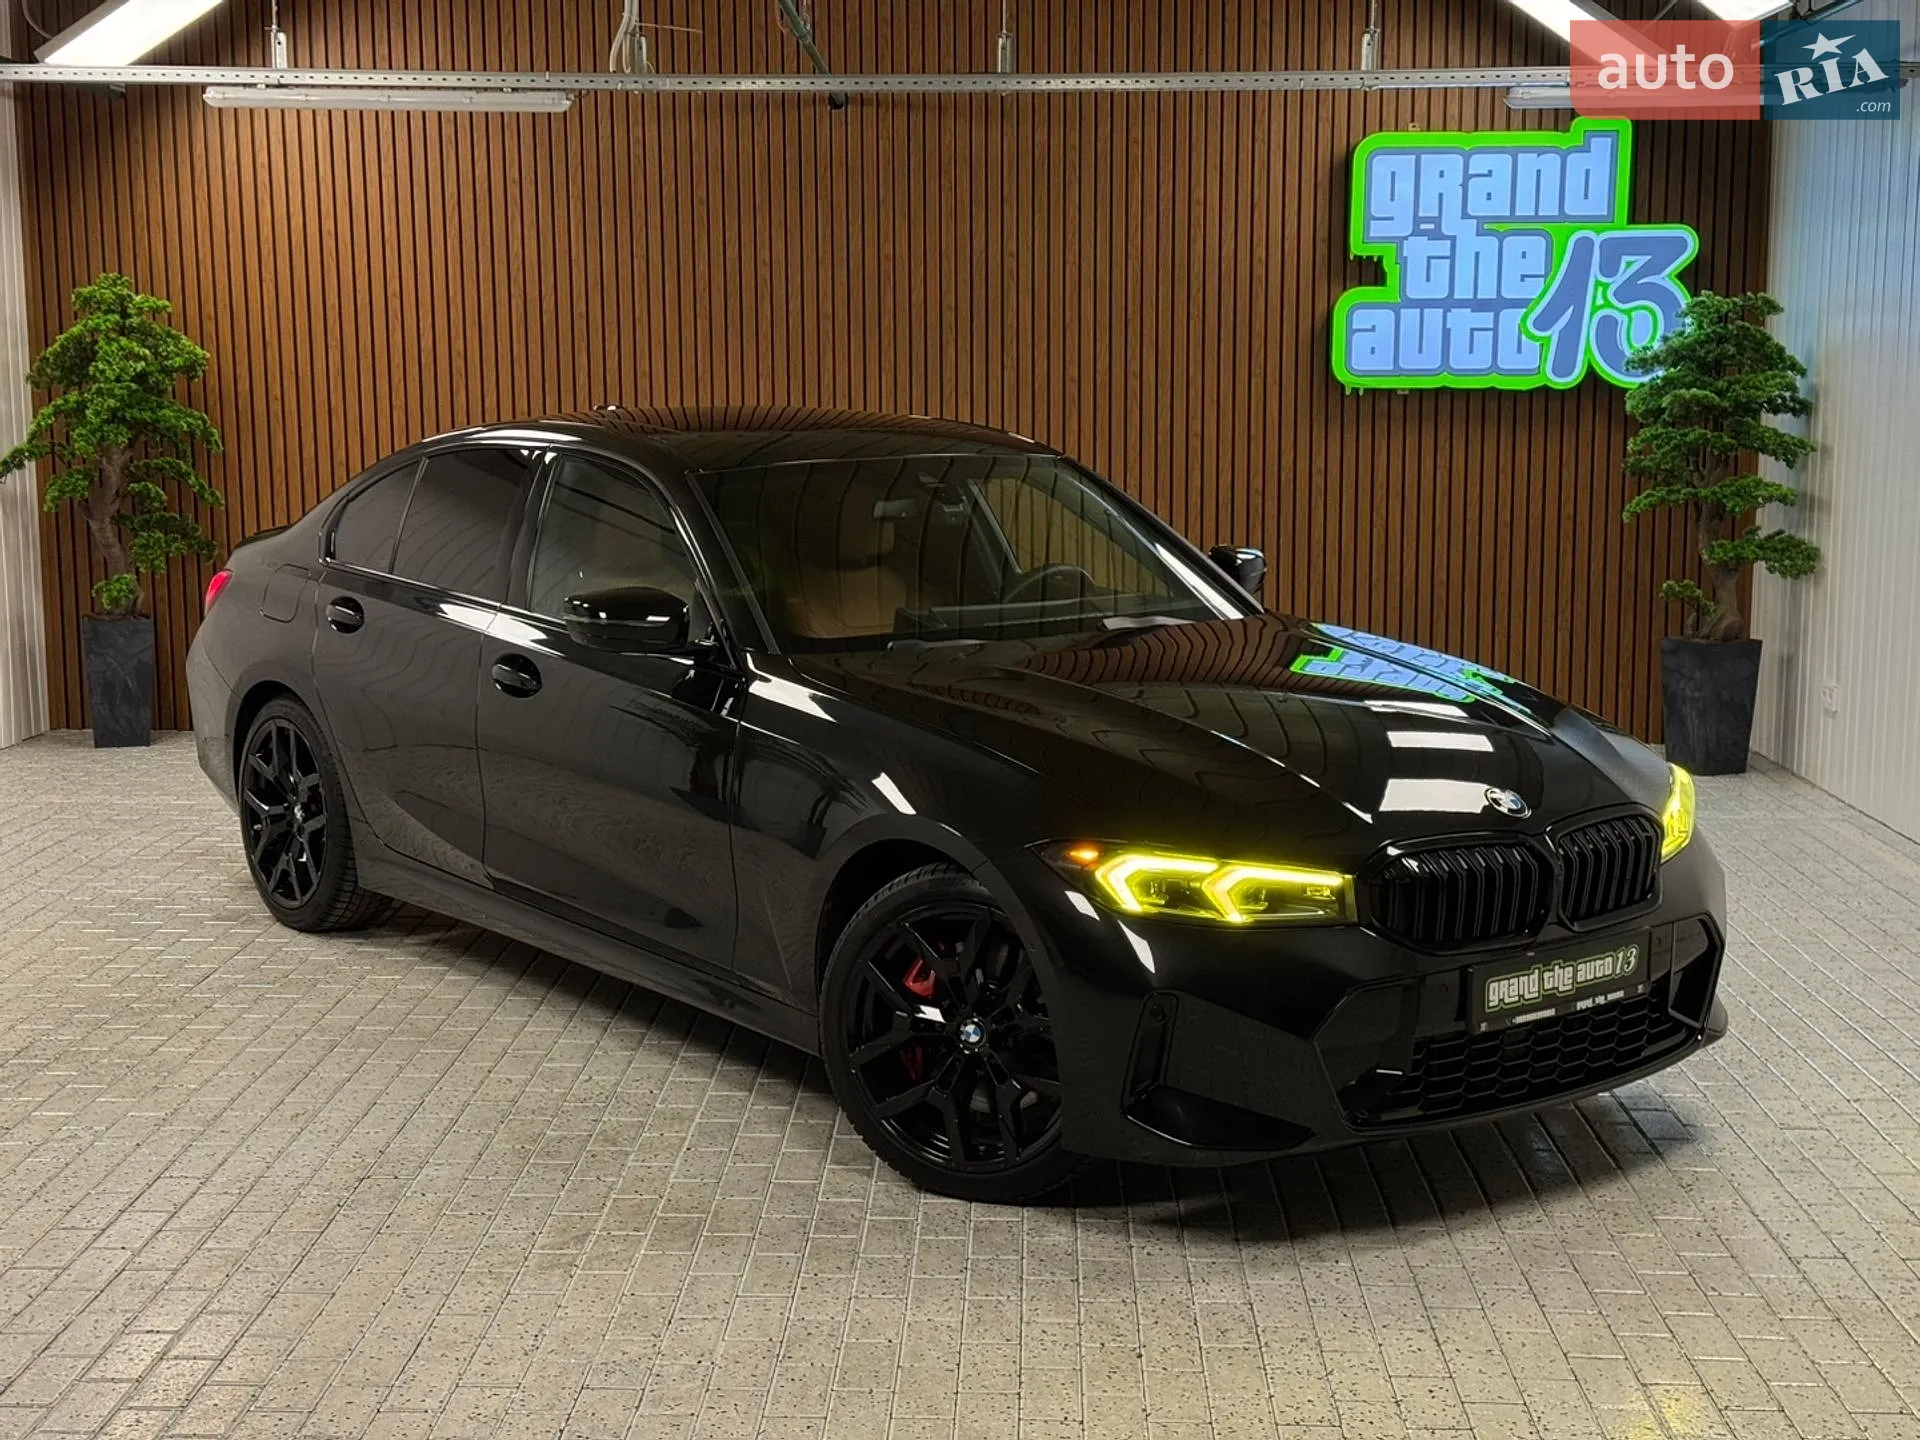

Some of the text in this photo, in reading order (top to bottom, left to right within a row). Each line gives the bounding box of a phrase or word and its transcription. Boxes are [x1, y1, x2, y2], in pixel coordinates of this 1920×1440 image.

[1350, 229, 1698, 384] auto 13
[1402, 219, 1548, 300] the
